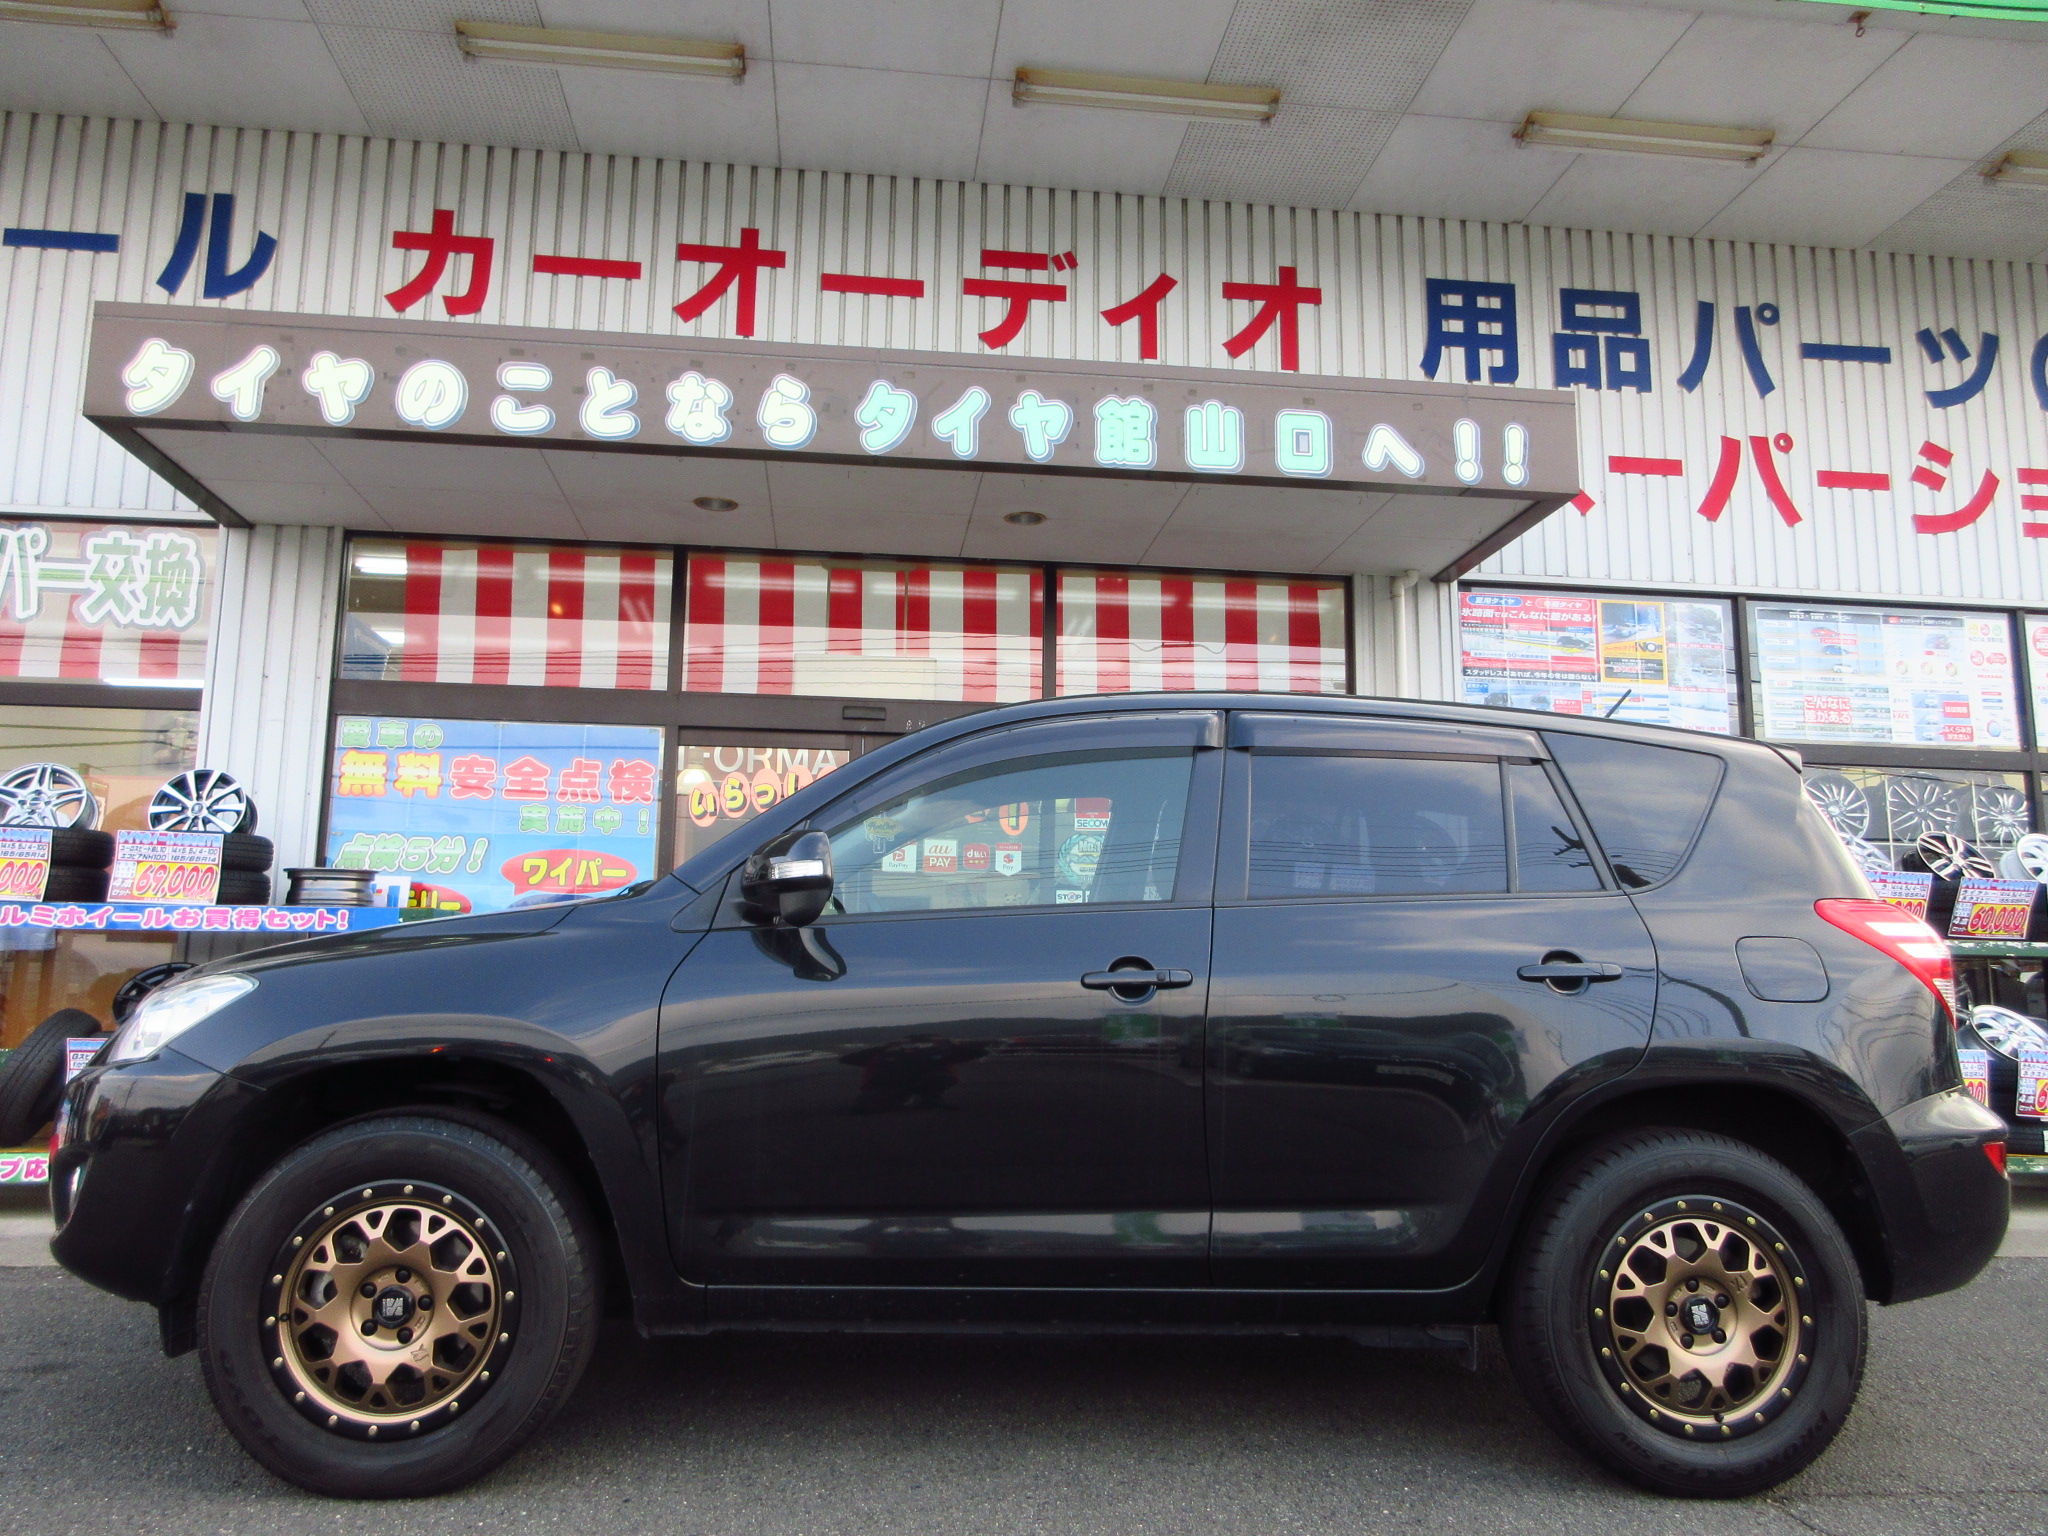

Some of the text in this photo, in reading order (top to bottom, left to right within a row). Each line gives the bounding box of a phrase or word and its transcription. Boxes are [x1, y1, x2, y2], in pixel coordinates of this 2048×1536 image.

[3, 192, 278, 299] ール
[384, 209, 1322, 371] カーオーディオ
[1572, 433, 2048, 539] ーパーショ
[341, 719, 444, 749] 愛車の
[1077, 819, 1108, 827] SECOM
[929, 844, 952, 855] au
[929, 857, 950, 867] PAY
[135, 863, 217, 896] 69,000
[523, 858, 628, 886] ワイパー
[0, 905, 350, 930] ルミホイールお買得セット!
[1969, 905, 2029, 933] 60,000
